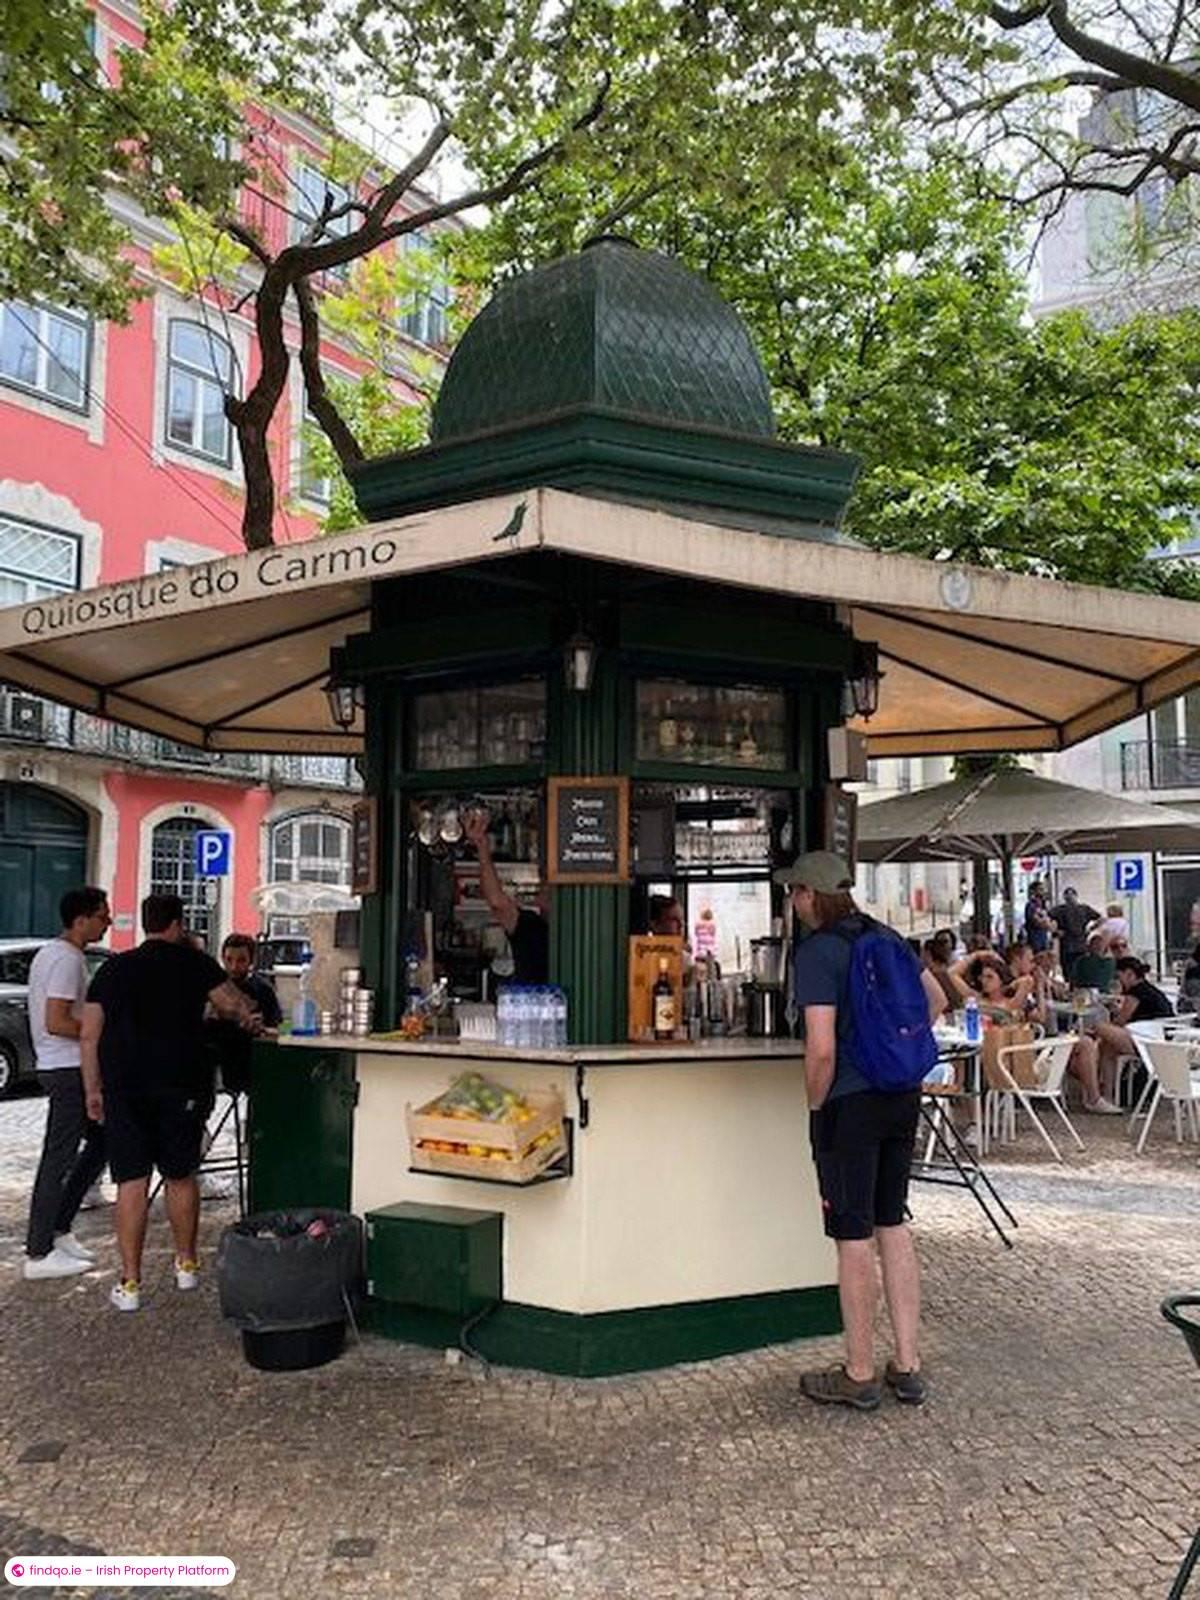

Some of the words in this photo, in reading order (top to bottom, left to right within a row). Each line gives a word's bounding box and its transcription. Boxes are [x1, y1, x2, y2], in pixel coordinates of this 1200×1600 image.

[22, 581, 178, 635] Quiosque
[190, 562, 239, 598] do
[257, 540, 397, 587] Carmo
[202, 835, 223, 873] P
[1120, 861, 1138, 889] P
